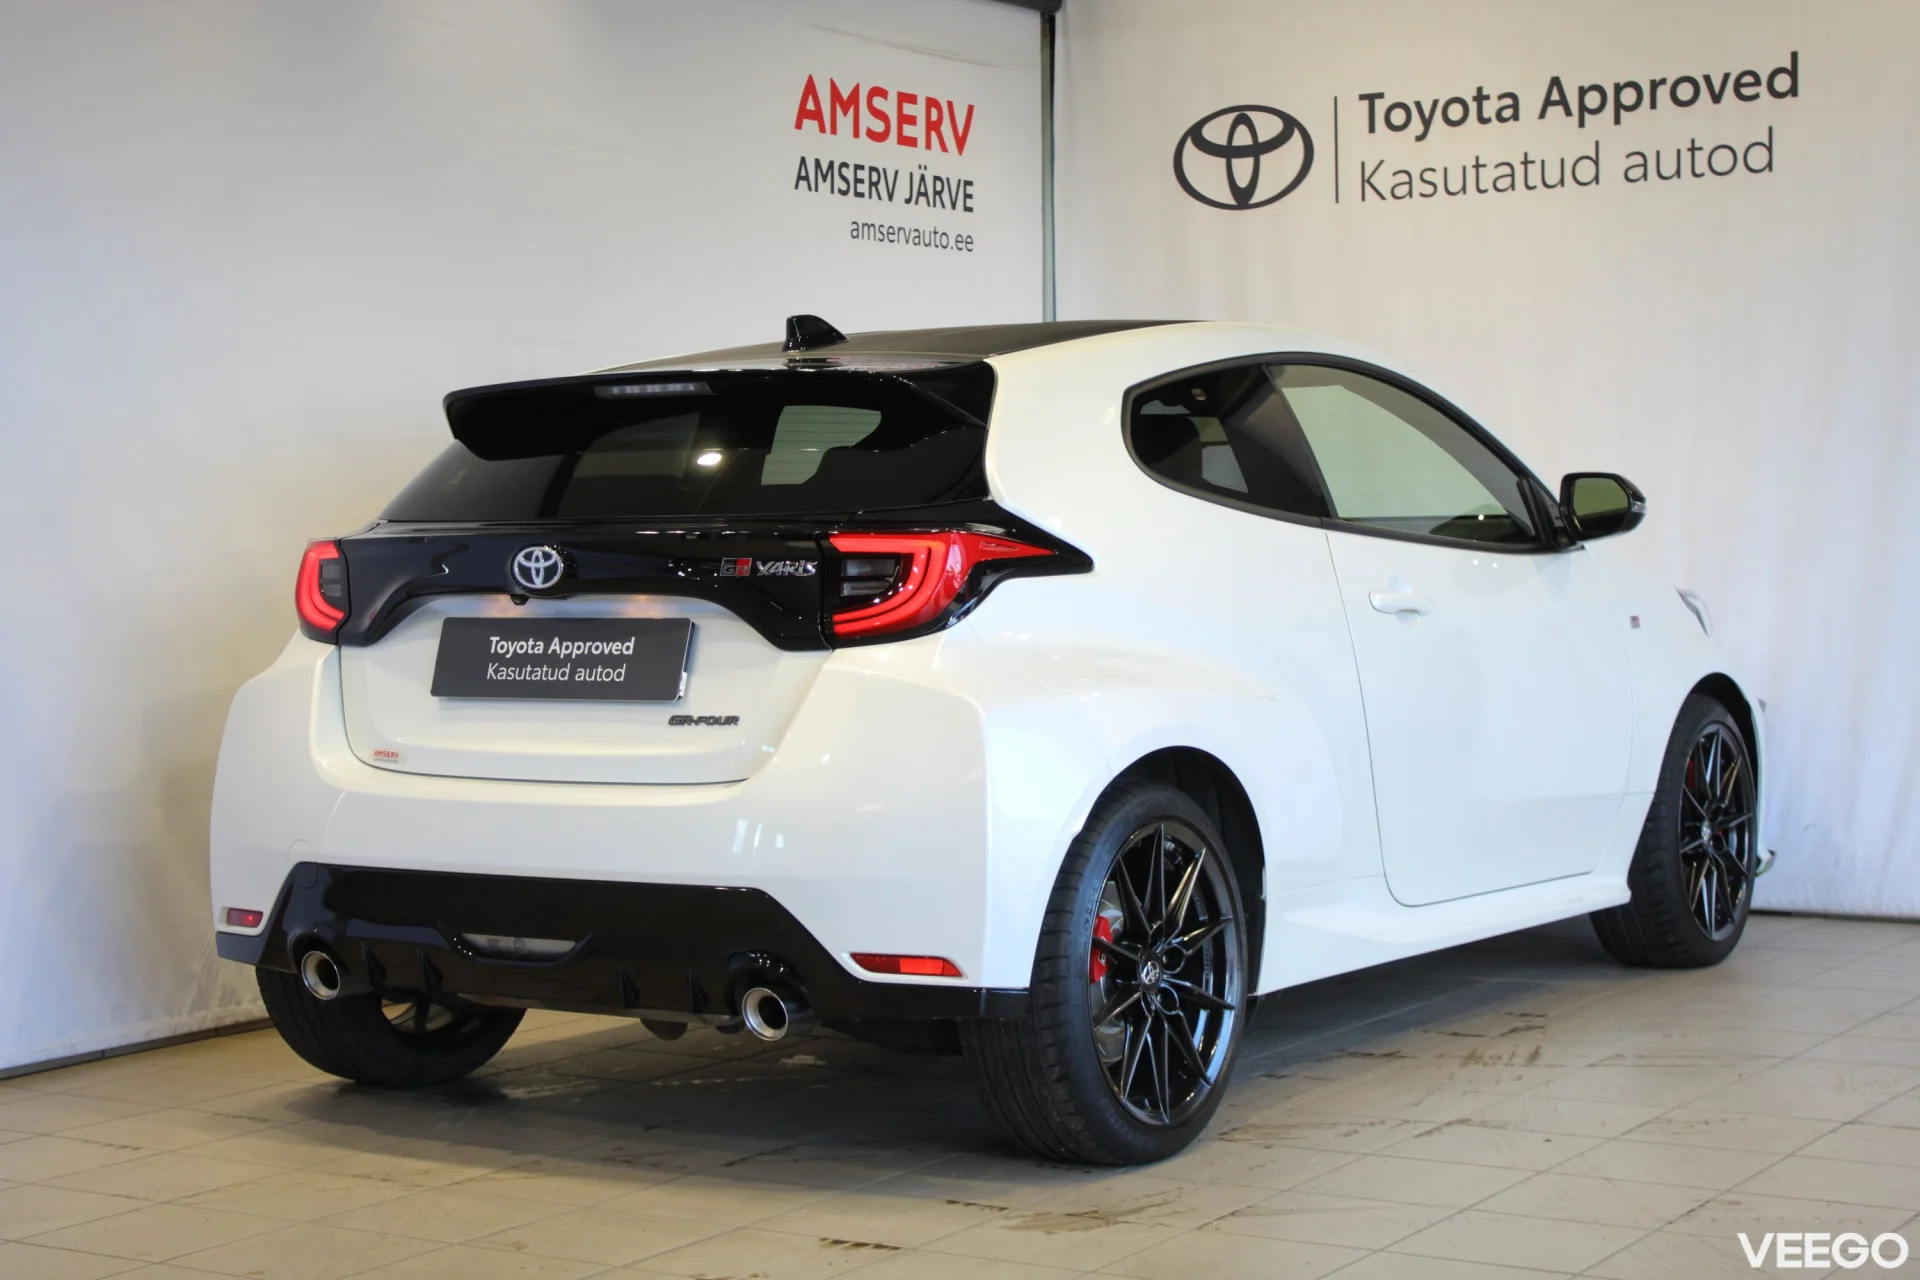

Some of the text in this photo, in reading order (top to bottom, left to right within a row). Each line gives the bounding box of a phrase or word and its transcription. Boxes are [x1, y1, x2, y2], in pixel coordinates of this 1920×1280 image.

[1358, 50, 1799, 142] Toyota Approved
[794, 73, 975, 156] AMSERV
[1360, 125, 1773, 202] Kasutatud autod
[794, 155, 974, 213] AMSERV JÄRVE
[850, 220, 974, 252] amservauto.ee
[721, 560, 818, 576] GR YARIS
[489, 636, 636, 660] Toyota Approved
[486, 662, 627, 682] Kasutatud autod
[373, 750, 400, 760] AMSERV
